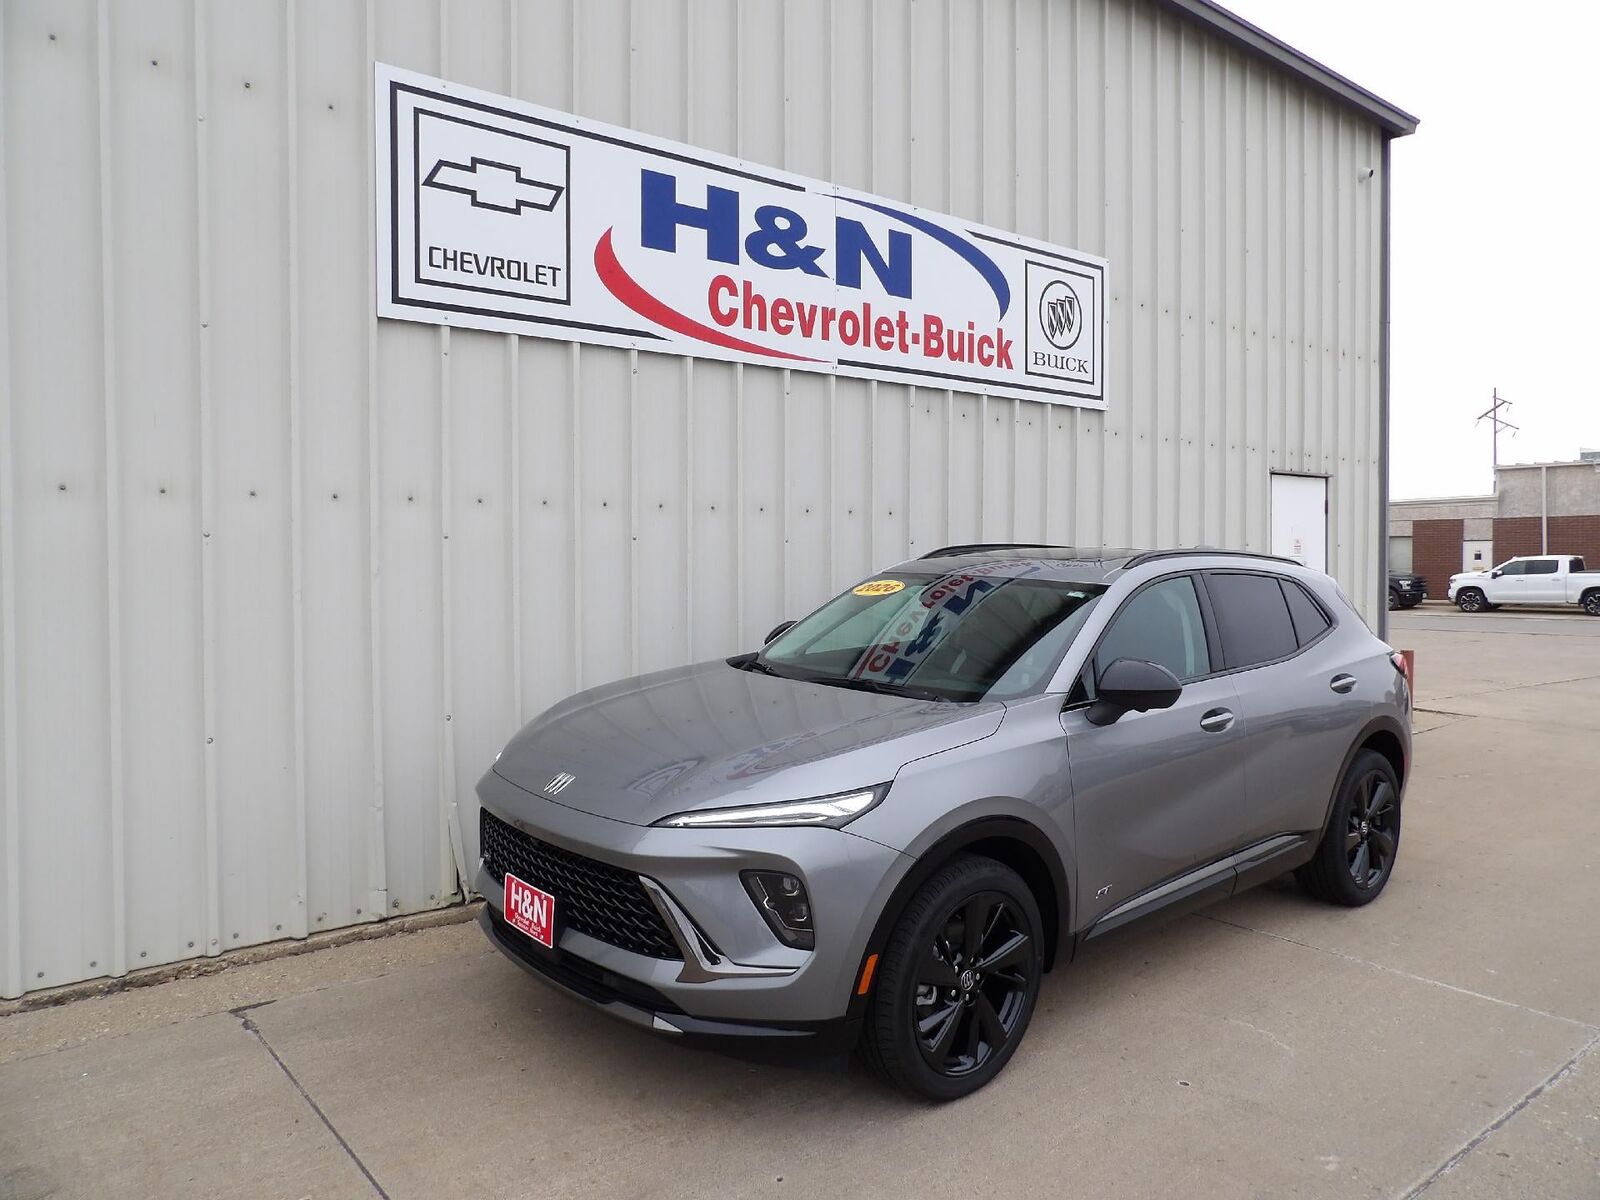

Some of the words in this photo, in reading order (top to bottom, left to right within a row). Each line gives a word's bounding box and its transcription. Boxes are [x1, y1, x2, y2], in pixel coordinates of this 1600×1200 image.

[641, 168, 912, 299] H&N
[428, 246, 561, 287] CHEVROLET
[708, 274, 1014, 370] Chevrolet-Buick
[1033, 351, 1088, 374] BUICK
[511, 881, 547, 928] H&N
